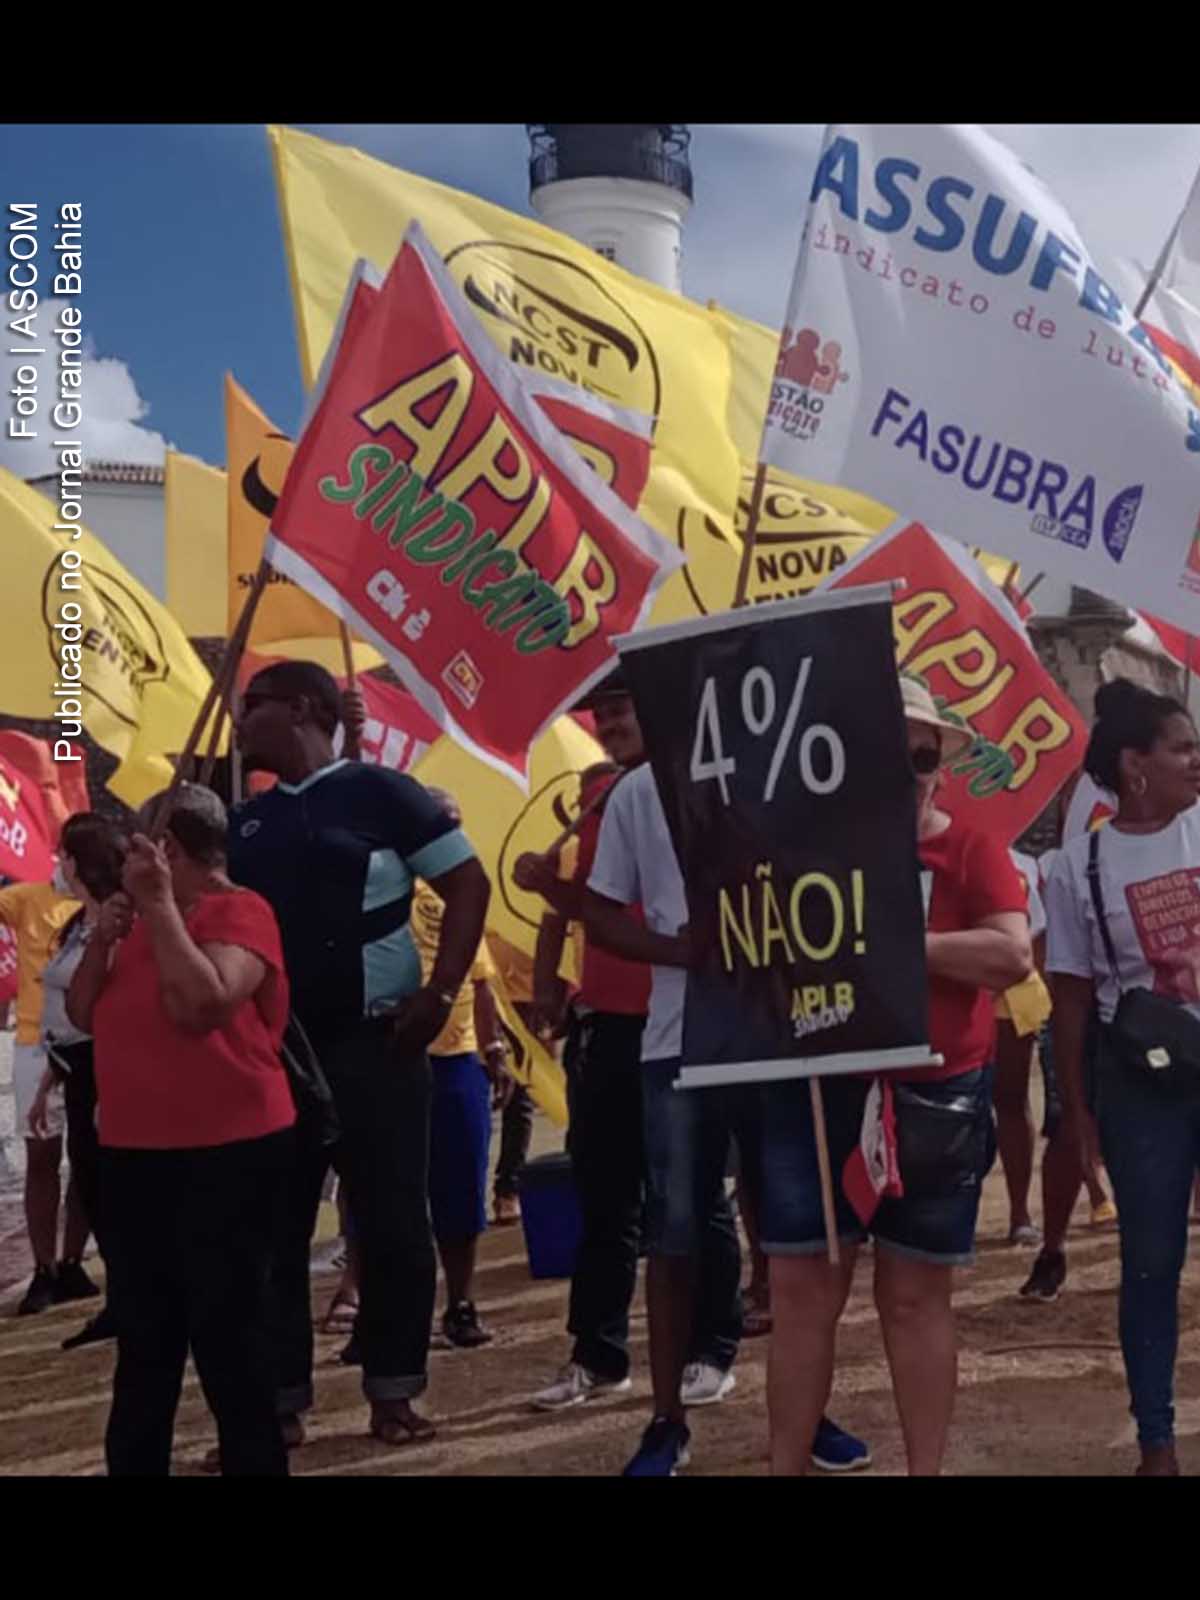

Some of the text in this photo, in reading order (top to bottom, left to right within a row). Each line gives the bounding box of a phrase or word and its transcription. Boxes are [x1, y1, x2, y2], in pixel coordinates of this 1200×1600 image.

[493, 282, 610, 367] NCST
[511, 337, 578, 385] NOV
[808, 222, 1171, 391] indicato de luta
[355, 350, 618, 650] APLB
[871, 388, 1096, 532] FASUBRA
[319, 443, 573, 656] SINDICATO
[756, 545, 848, 584] NOVA
[690, 656, 846, 806] 4%
[892, 589, 1071, 792] APLB
[719, 862, 866, 971] NÃO!
